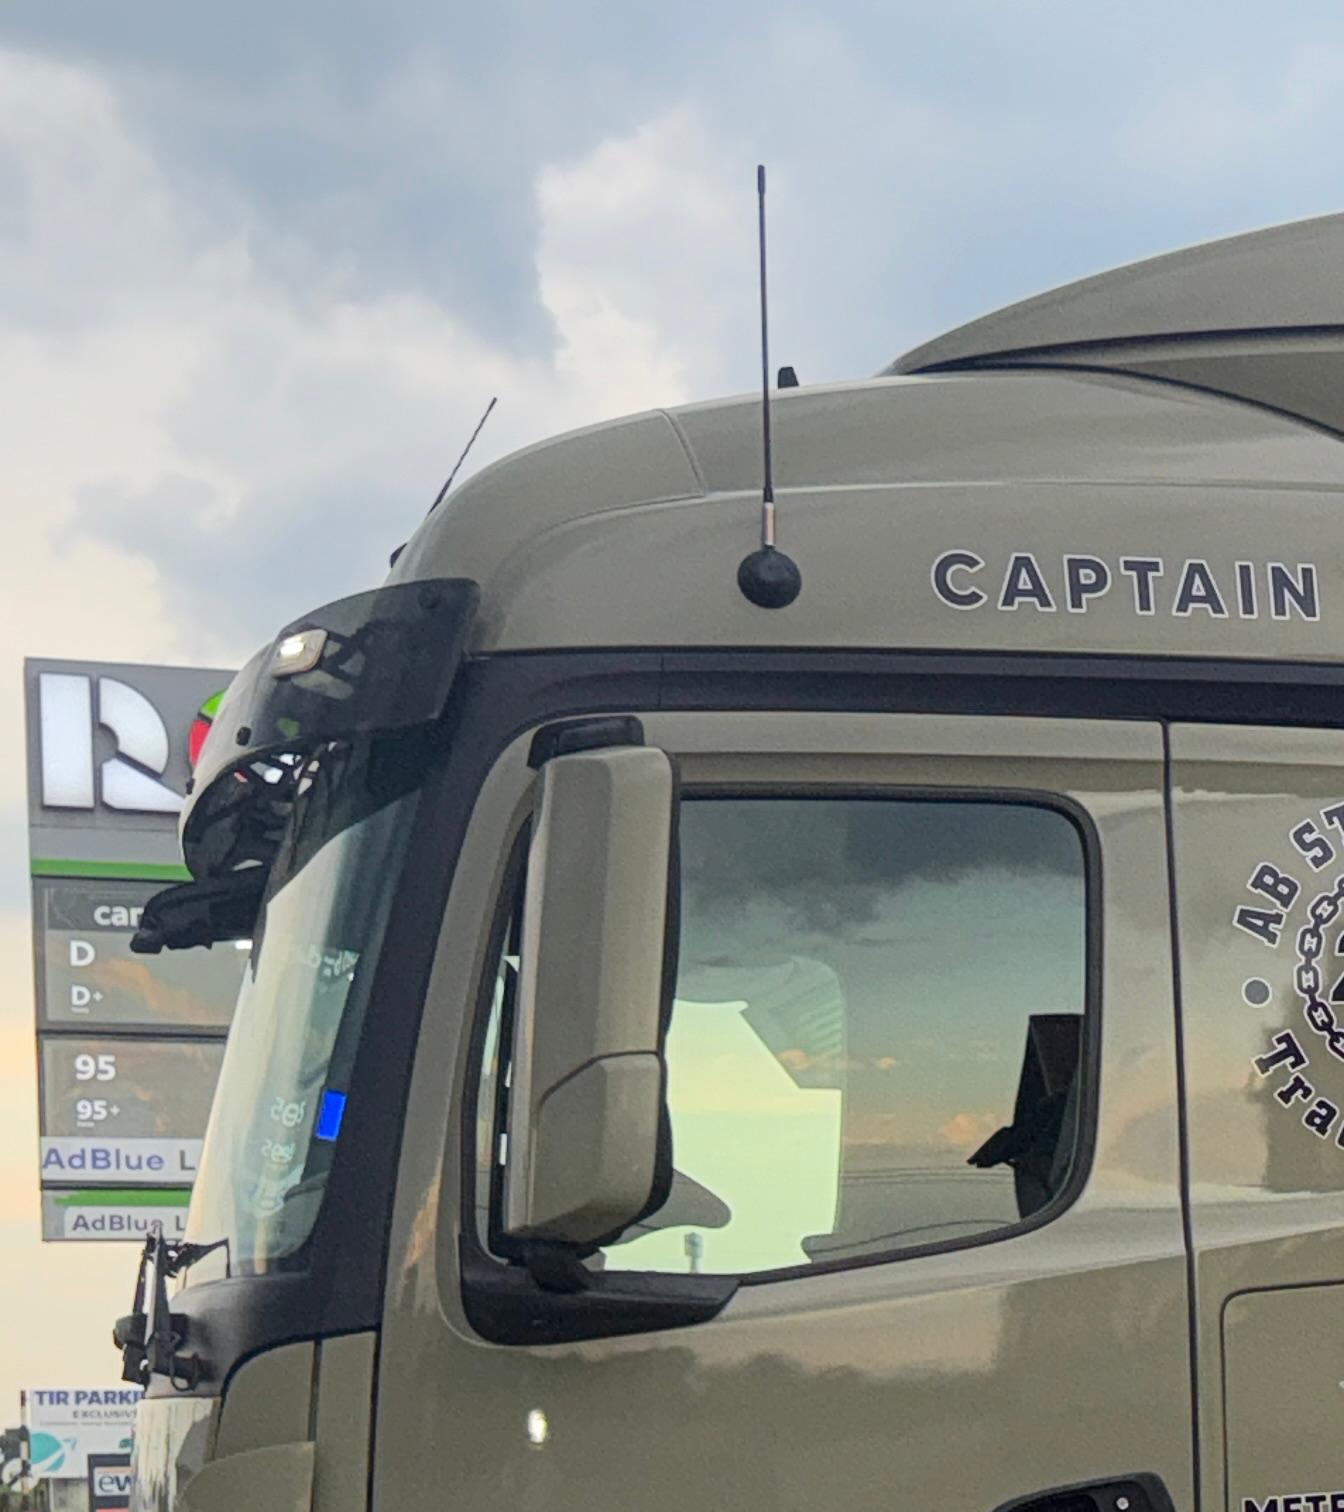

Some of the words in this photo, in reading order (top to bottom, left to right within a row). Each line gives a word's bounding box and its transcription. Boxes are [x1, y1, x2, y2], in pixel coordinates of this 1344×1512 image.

[931, 549, 1320, 621] CAPTAIN
[1233, 862, 1300, 946] AB
[70, 940, 95, 966] D
[75, 1054, 116, 1081] 95
[76, 1099, 120, 1120] 95+
[43, 1148, 165, 1171] AdBlue
[35, 1390, 69, 1405] TIR
